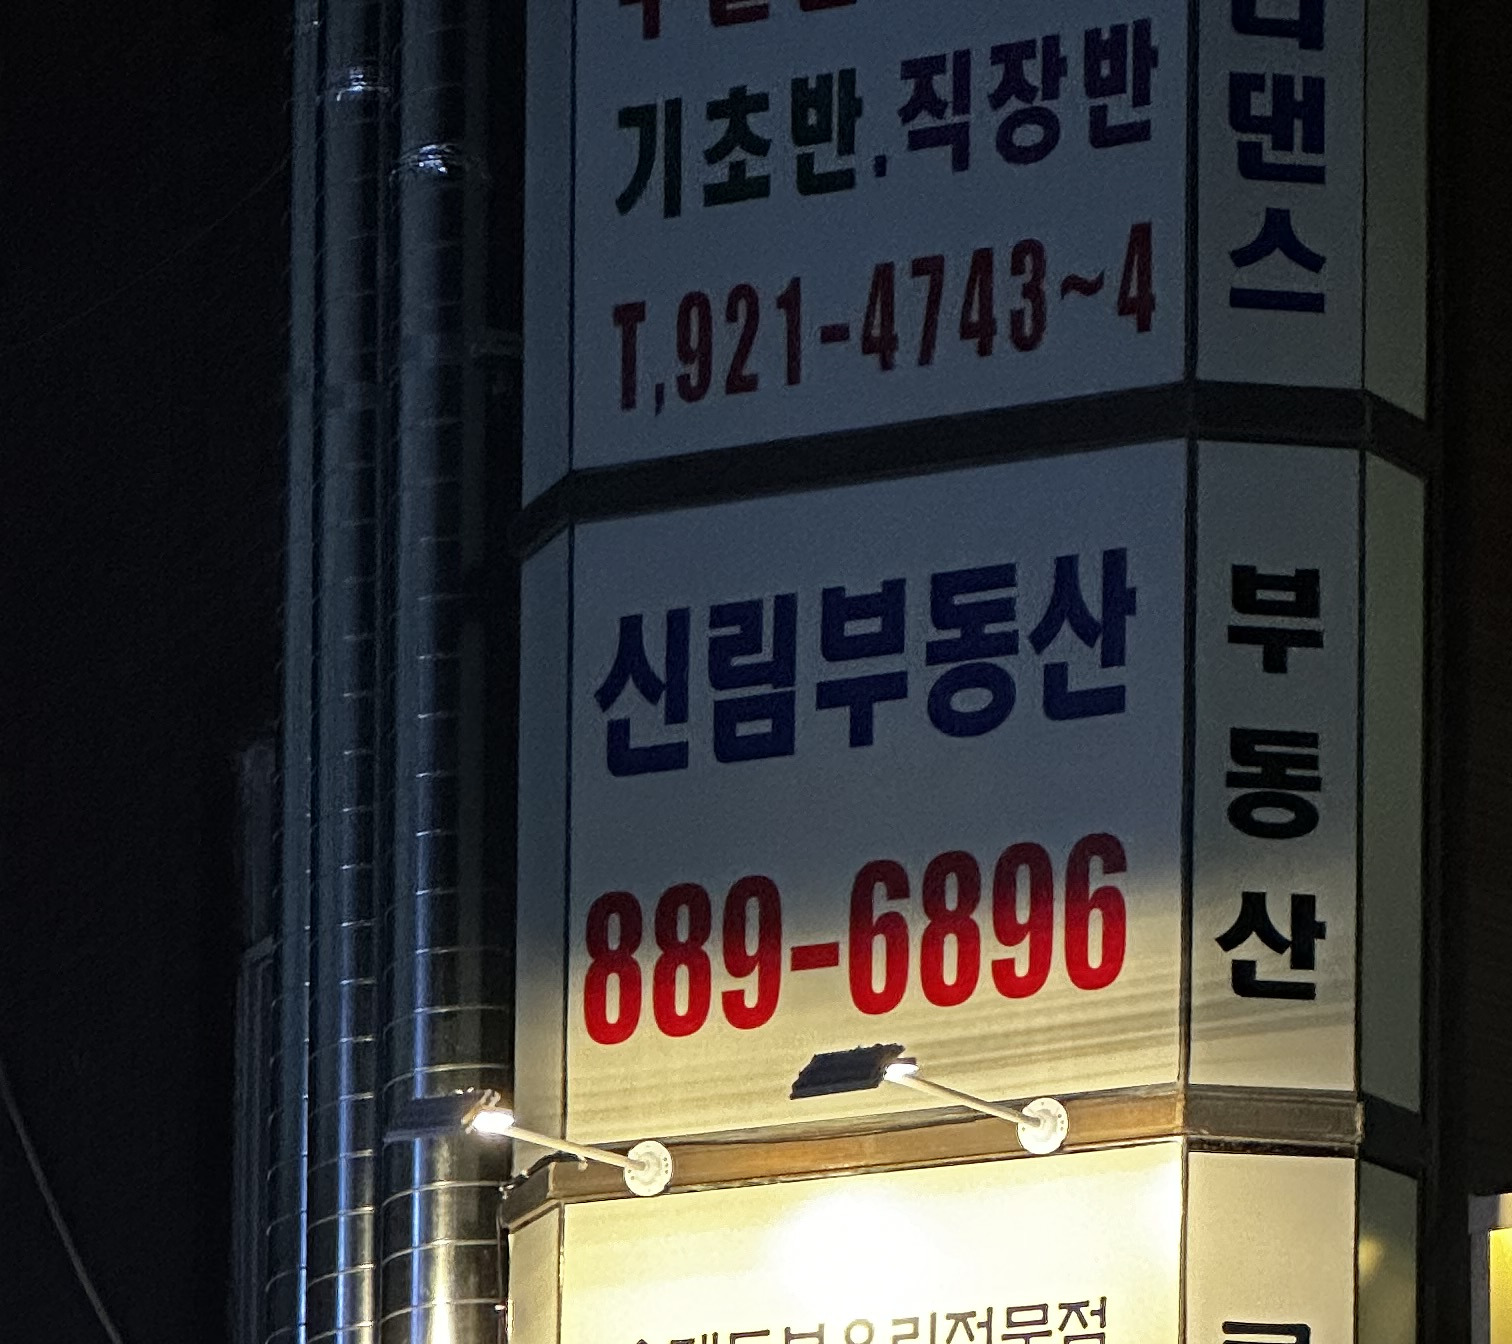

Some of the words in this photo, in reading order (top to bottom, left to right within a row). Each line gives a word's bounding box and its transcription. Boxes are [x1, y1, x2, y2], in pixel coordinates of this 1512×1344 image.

[594, 547, 1137, 777] 신림부동산
[1215, 564, 1327, 999] 부동산
[584, 833, 1127, 1045] 889-6896
